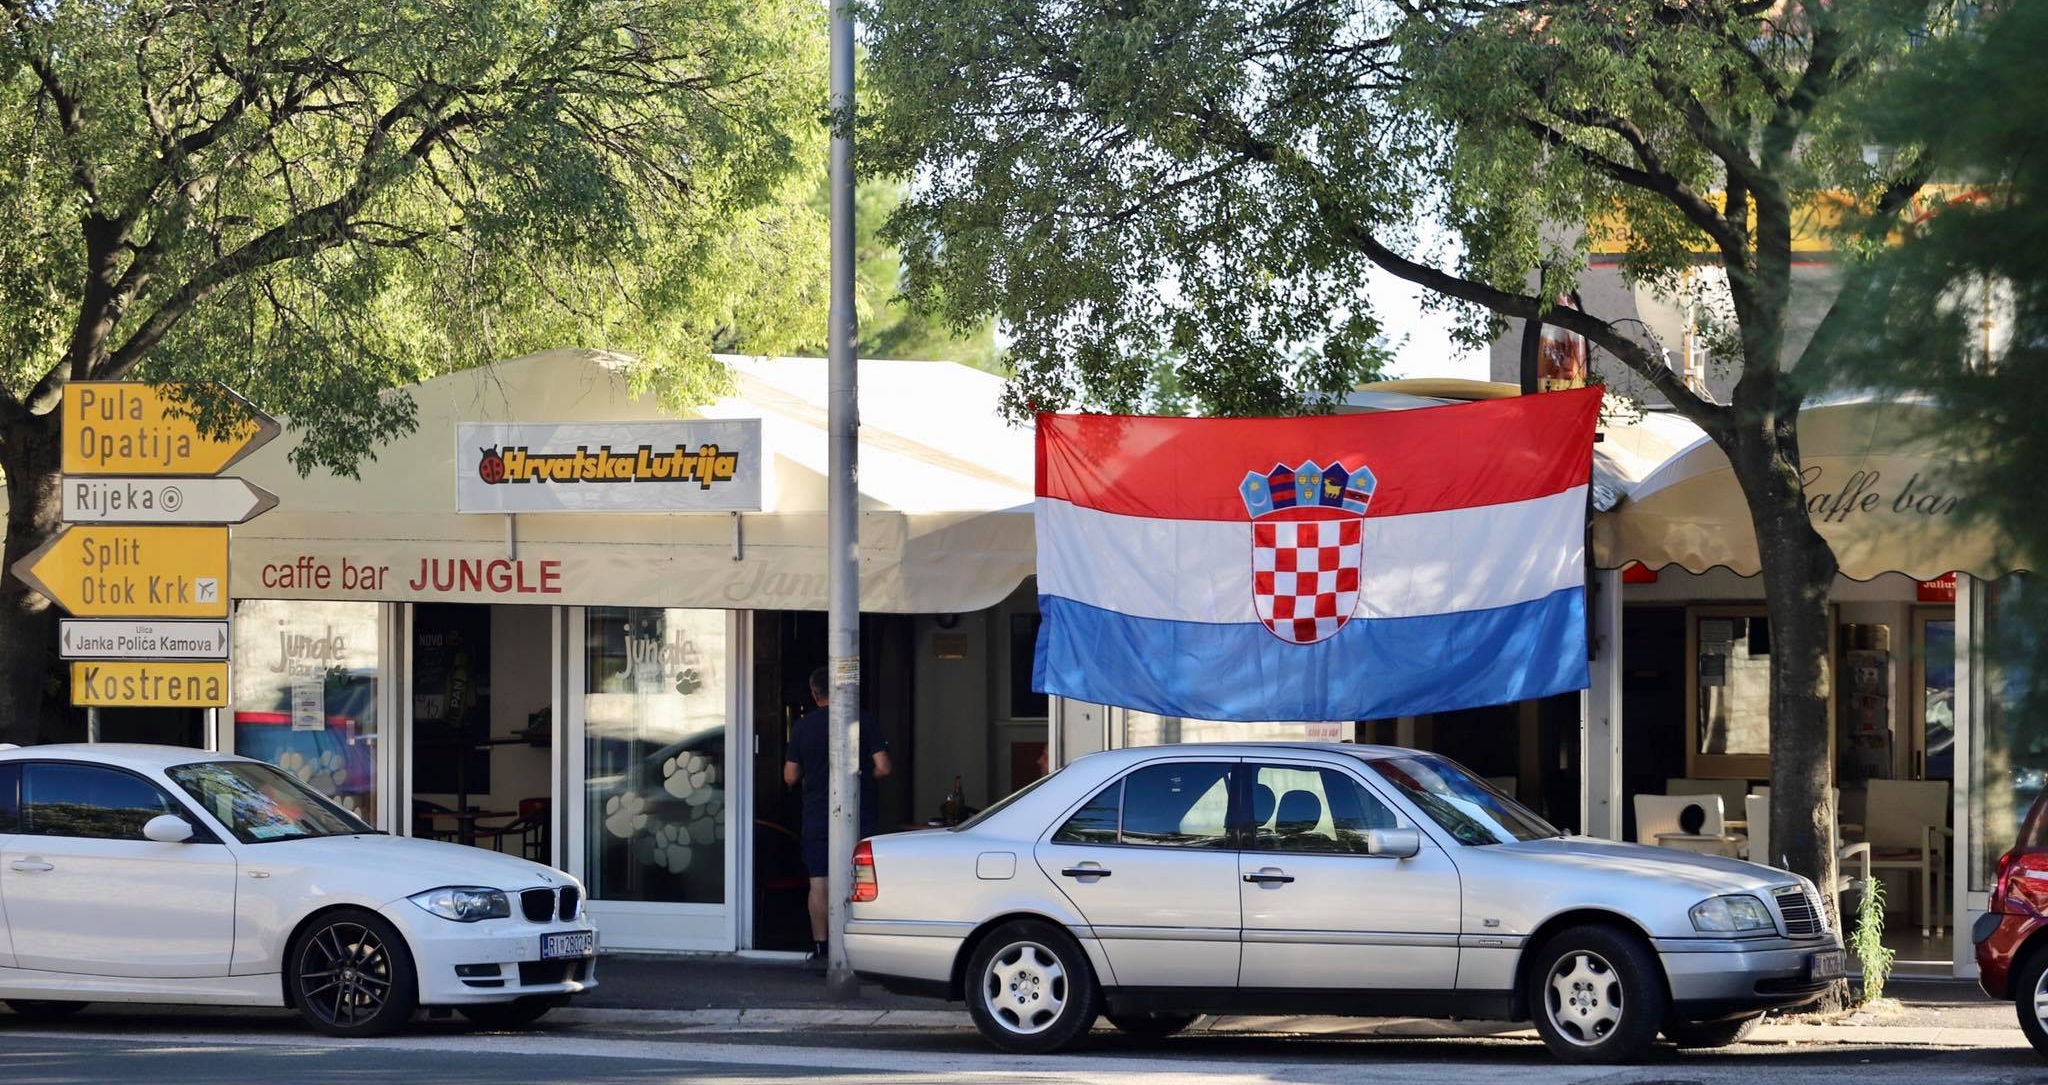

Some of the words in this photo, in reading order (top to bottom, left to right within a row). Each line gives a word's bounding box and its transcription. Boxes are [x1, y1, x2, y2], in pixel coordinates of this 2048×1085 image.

[80, 389, 143, 421] Pula
[80, 426, 191, 466] Opatija
[77, 483, 154, 517] Rijeka
[1893, 473, 1966, 515] bar
[82, 537, 140, 573] Split
[82, 576, 135, 604] Otok
[149, 576, 188, 604] Krk
[262, 556, 331, 589] caffe
[342, 557, 389, 590] bar
[409, 558, 562, 593] JUNGLE
[77, 637, 114, 652] Janka
[117, 636, 156, 652] Polića
[160, 637, 211, 652] Kamova
[136, 625, 153, 635] Ulica
[270, 619, 346, 674] jungle
[615, 622, 701, 679] jungle
[84, 667, 220, 701] Kostrena
